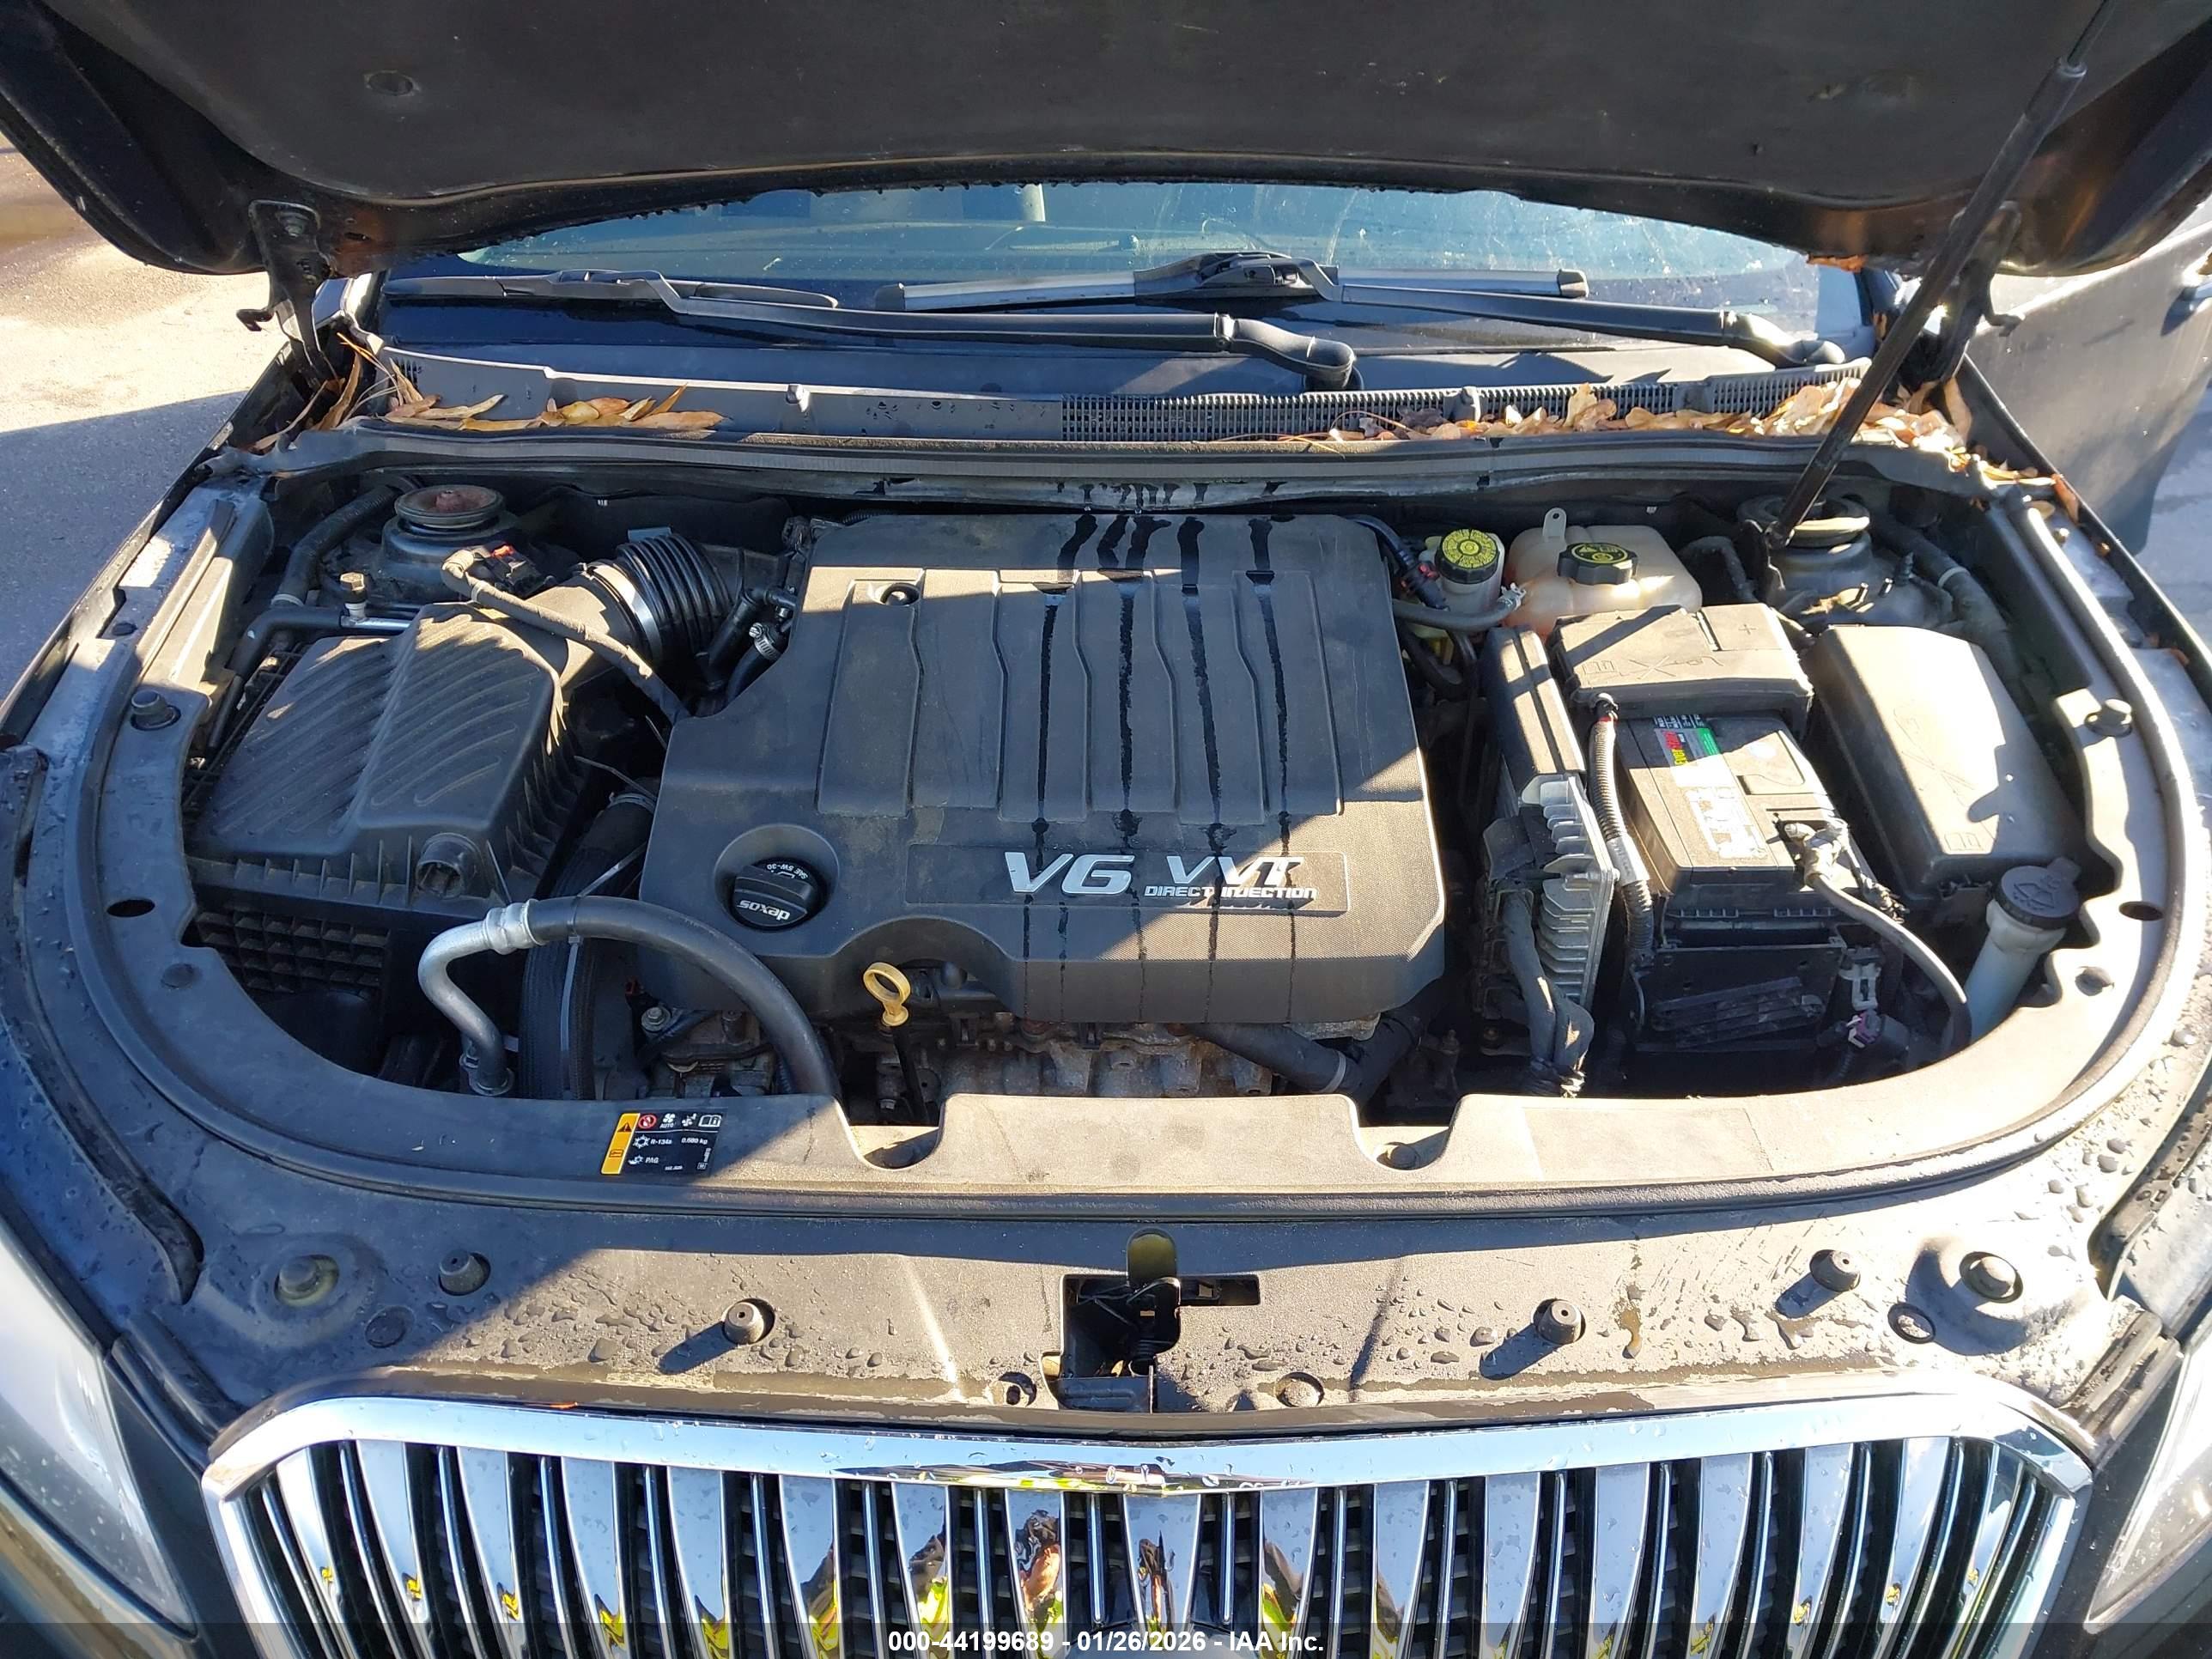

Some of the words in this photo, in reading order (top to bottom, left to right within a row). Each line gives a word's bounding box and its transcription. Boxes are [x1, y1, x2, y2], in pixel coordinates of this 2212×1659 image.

[793, 868, 808, 879] SAE
[1004, 851, 1135, 895] V6
[1166, 855, 1304, 885] VVT
[1144, 885, 1214, 897] DIRECT
[1221, 886, 1318, 900] INJECTION
[737, 900, 790, 921] dexos
